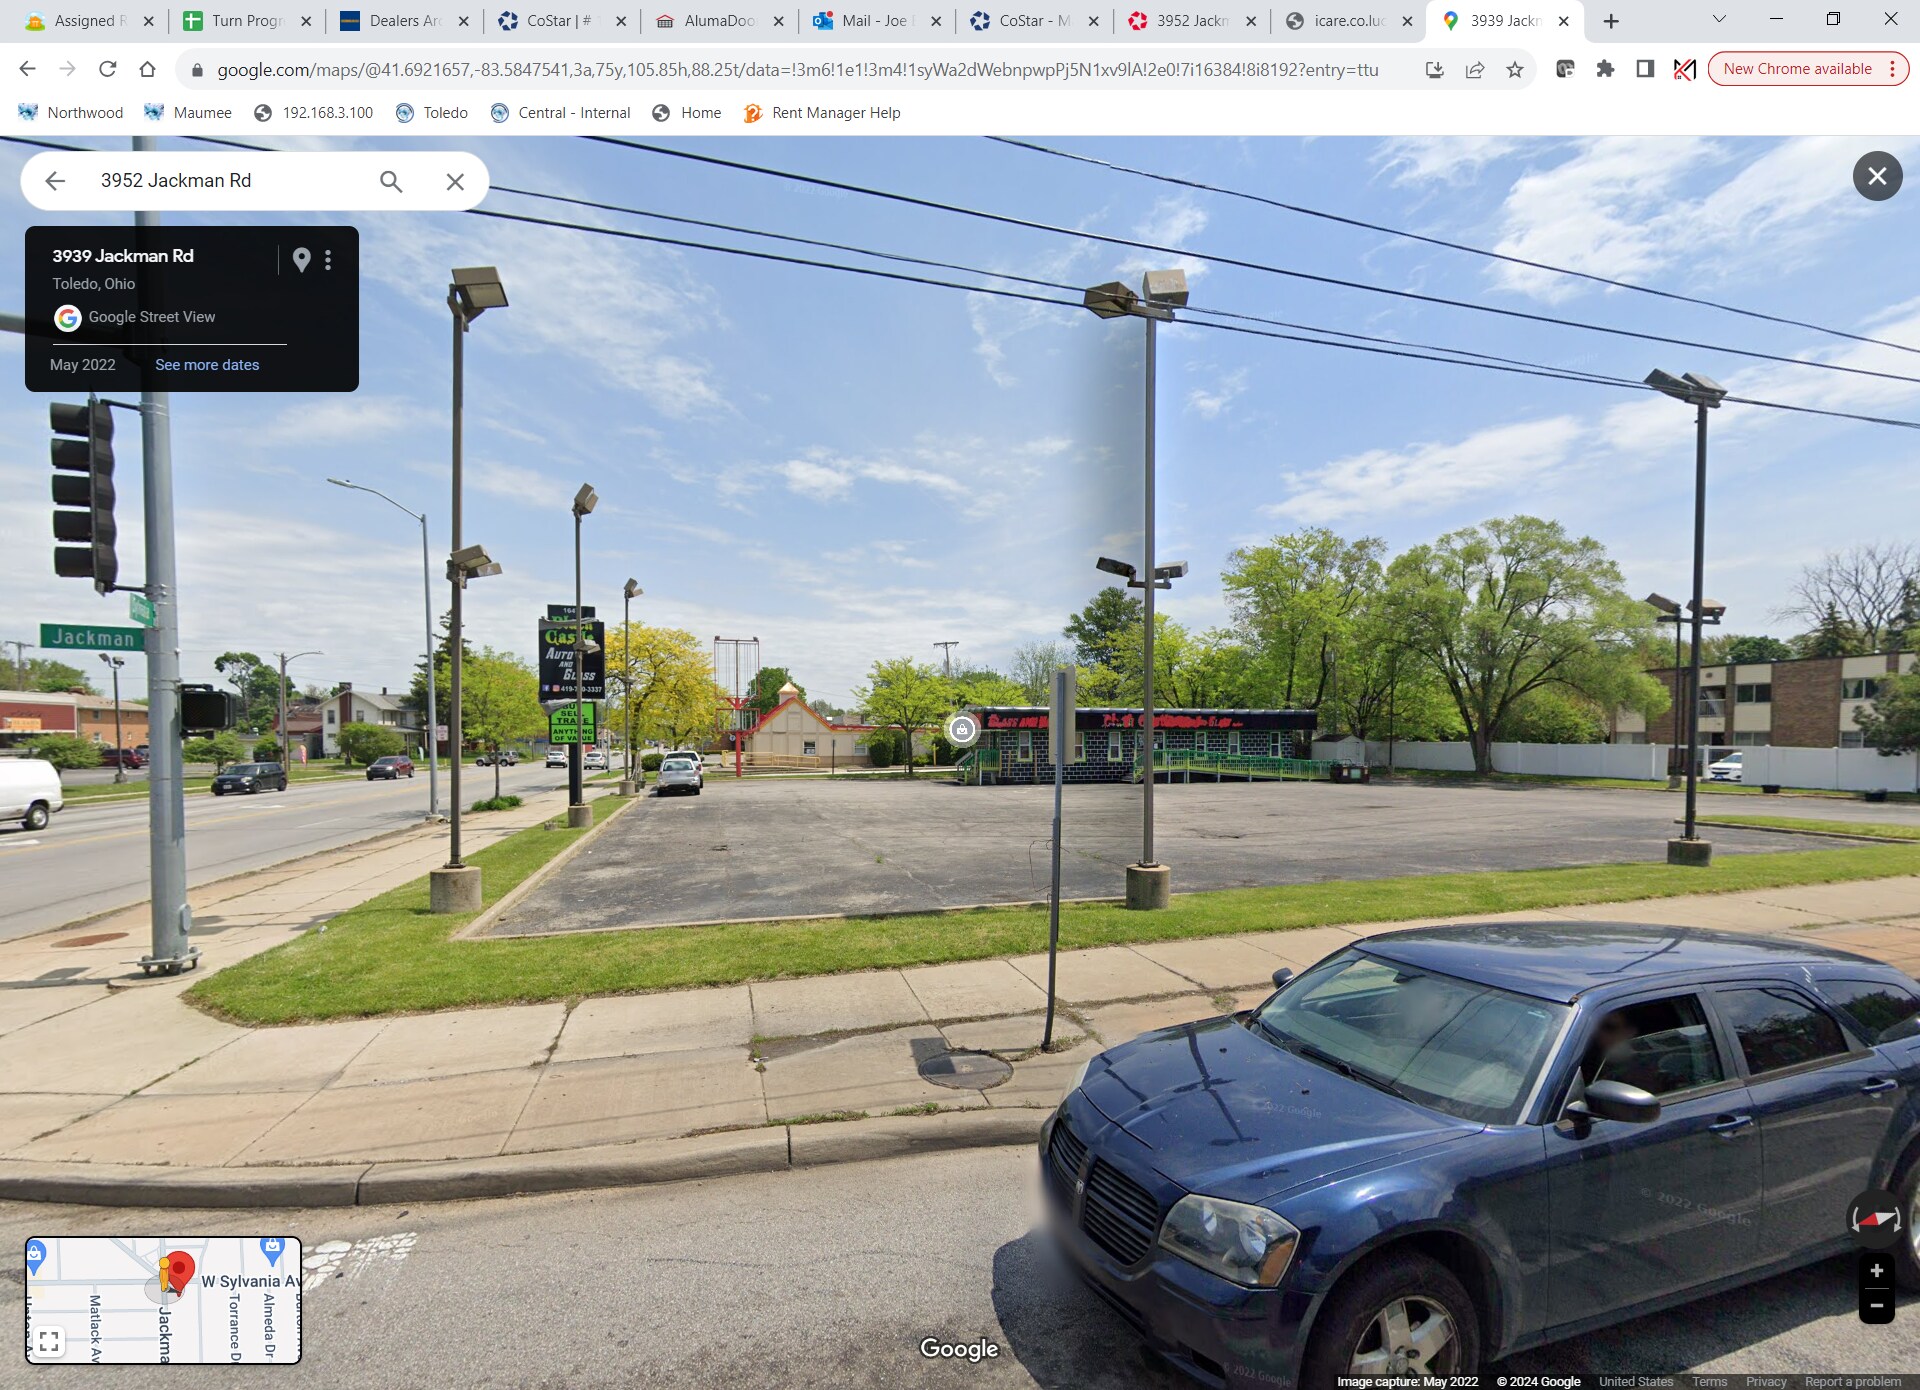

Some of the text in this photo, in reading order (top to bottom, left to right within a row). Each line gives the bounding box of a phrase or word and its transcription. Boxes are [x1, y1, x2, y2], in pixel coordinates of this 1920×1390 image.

[55, 15, 114, 29] Assigned
[213, 15, 242, 26] Turn
[371, 15, 419, 26] Dealers
[528, 15, 571, 26] CoStar
[844, 15, 870, 26] Mail
[885, 15, 906, 26] Joe
[1001, 15, 1044, 26] CoStar
[1158, 15, 1189, 26] 3952
[1472, 15, 1503, 26] 3939
[1725, 63, 1872, 74] New Chrome available
[49, 107, 123, 118] Northwood
[175, 107, 232, 118] Maumee
[284, 107, 373, 118] 192.168.3.100
[424, 107, 468, 118] Toledo
[519, 107, 565, 118] Central
[581, 107, 630, 118] Internal
[682, 107, 721, 118] Home
[773, 107, 900, 121] Rent Manager Help
[102, 173, 251, 187] 3952 Jackman Rd
[53, 249, 194, 262] 3939 Jackman Rd
[53, 277, 135, 291] Toledo, Ohio
[89, 310, 215, 325] Google Street View
[51, 359, 115, 373] May 2022
[156, 359, 259, 370] See more dates
[52, 628, 134, 646] Jackman
[200, 1275, 215, 1288] W
[220, 1275, 280, 1291] Sylvania
[90, 1295, 102, 1345] Matlack
[229, 1293, 240, 1349] Torrance
[263, 1293, 275, 1358] Almeda Dr
[1338, 1377, 1372, 1388] Image
[1375, 1377, 1420, 1388] capture:
[1424, 1377, 1447, 1388] May
[1450, 1377, 1479, 1386] 2022
[1510, 1377, 1538, 1386] 2024
[1541, 1376, 1581, 1388] Google
[1599, 1376, 1674, 1386] United States
[1693, 1376, 1728, 1386] Terms
[1747, 1376, 1787, 1389] Privacy
[1806, 1376, 1843, 1389] Report
[1855, 1376, 1902, 1389] problem
